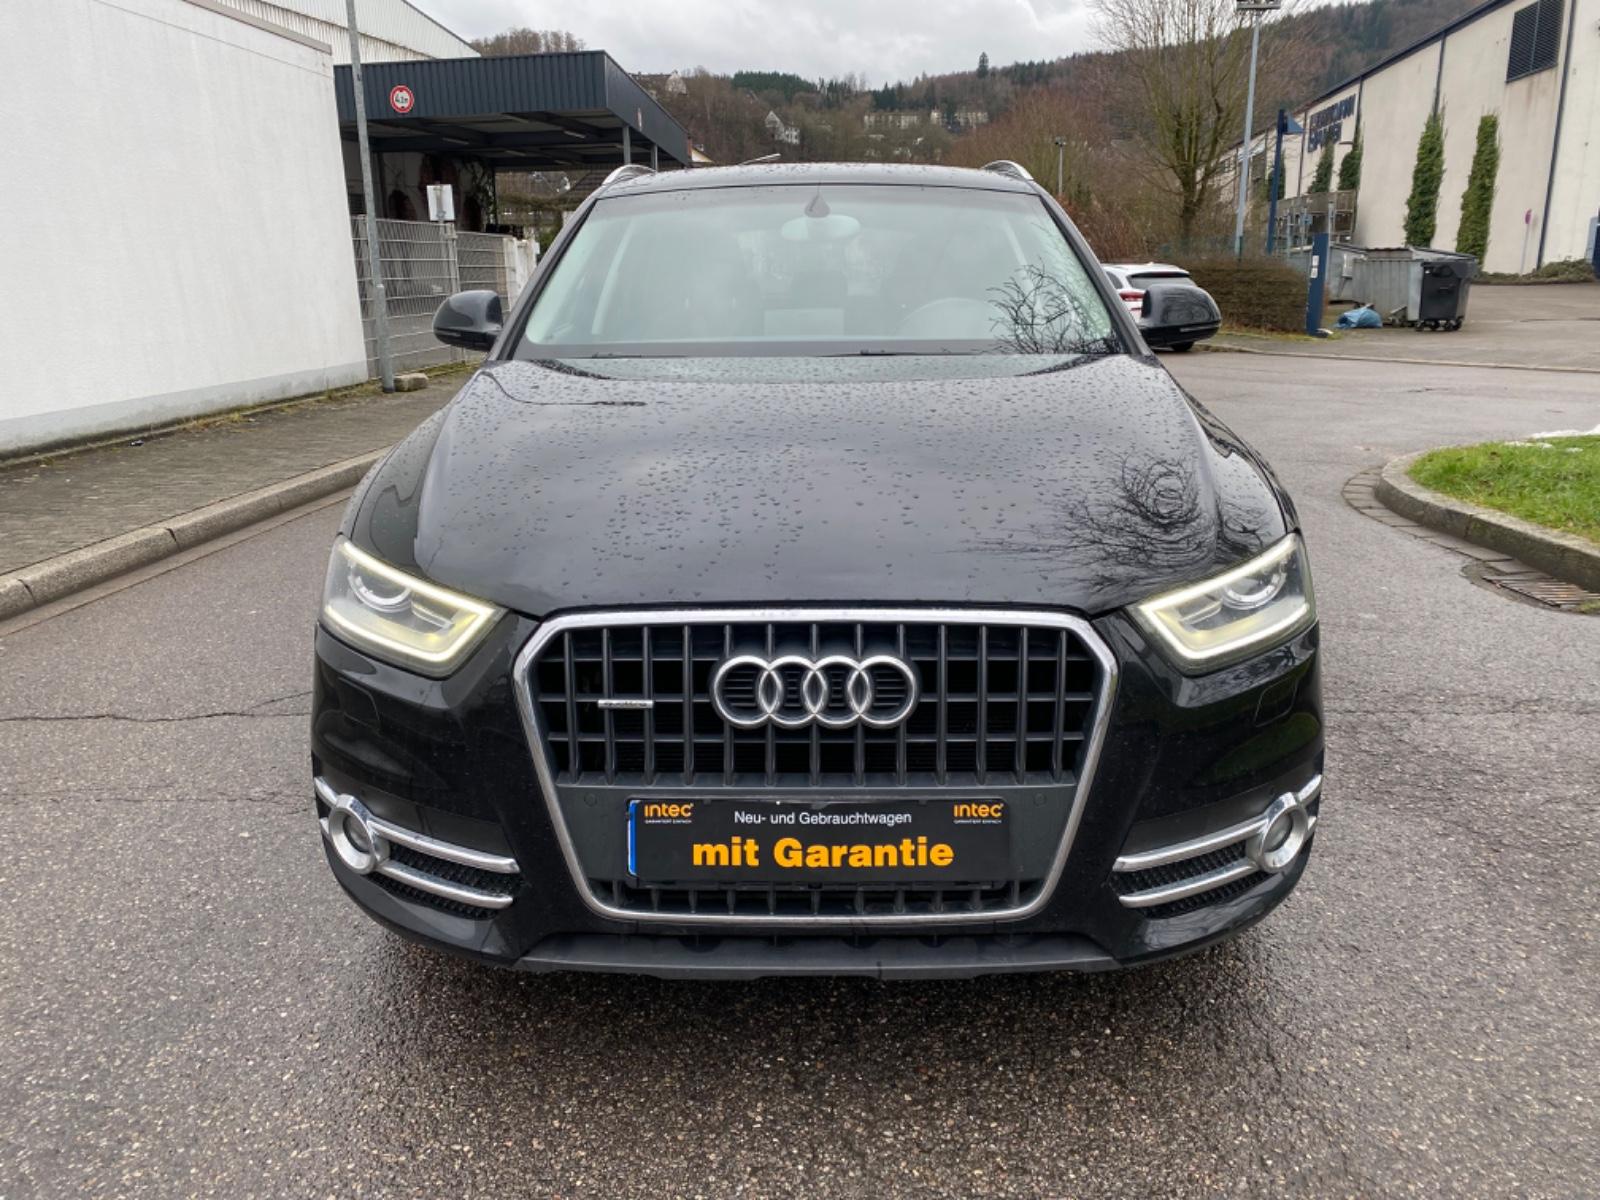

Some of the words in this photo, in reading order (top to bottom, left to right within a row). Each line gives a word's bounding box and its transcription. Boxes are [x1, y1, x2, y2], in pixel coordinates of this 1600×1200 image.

[644, 803, 692, 817] intec
[953, 803, 1002, 817] intec
[734, 811, 766, 824] Neu-
[770, 812, 795, 824] und
[799, 812, 912, 827] Gebrauchtwagen
[693, 836, 759, 866] mit
[774, 836, 954, 868] Garantie
